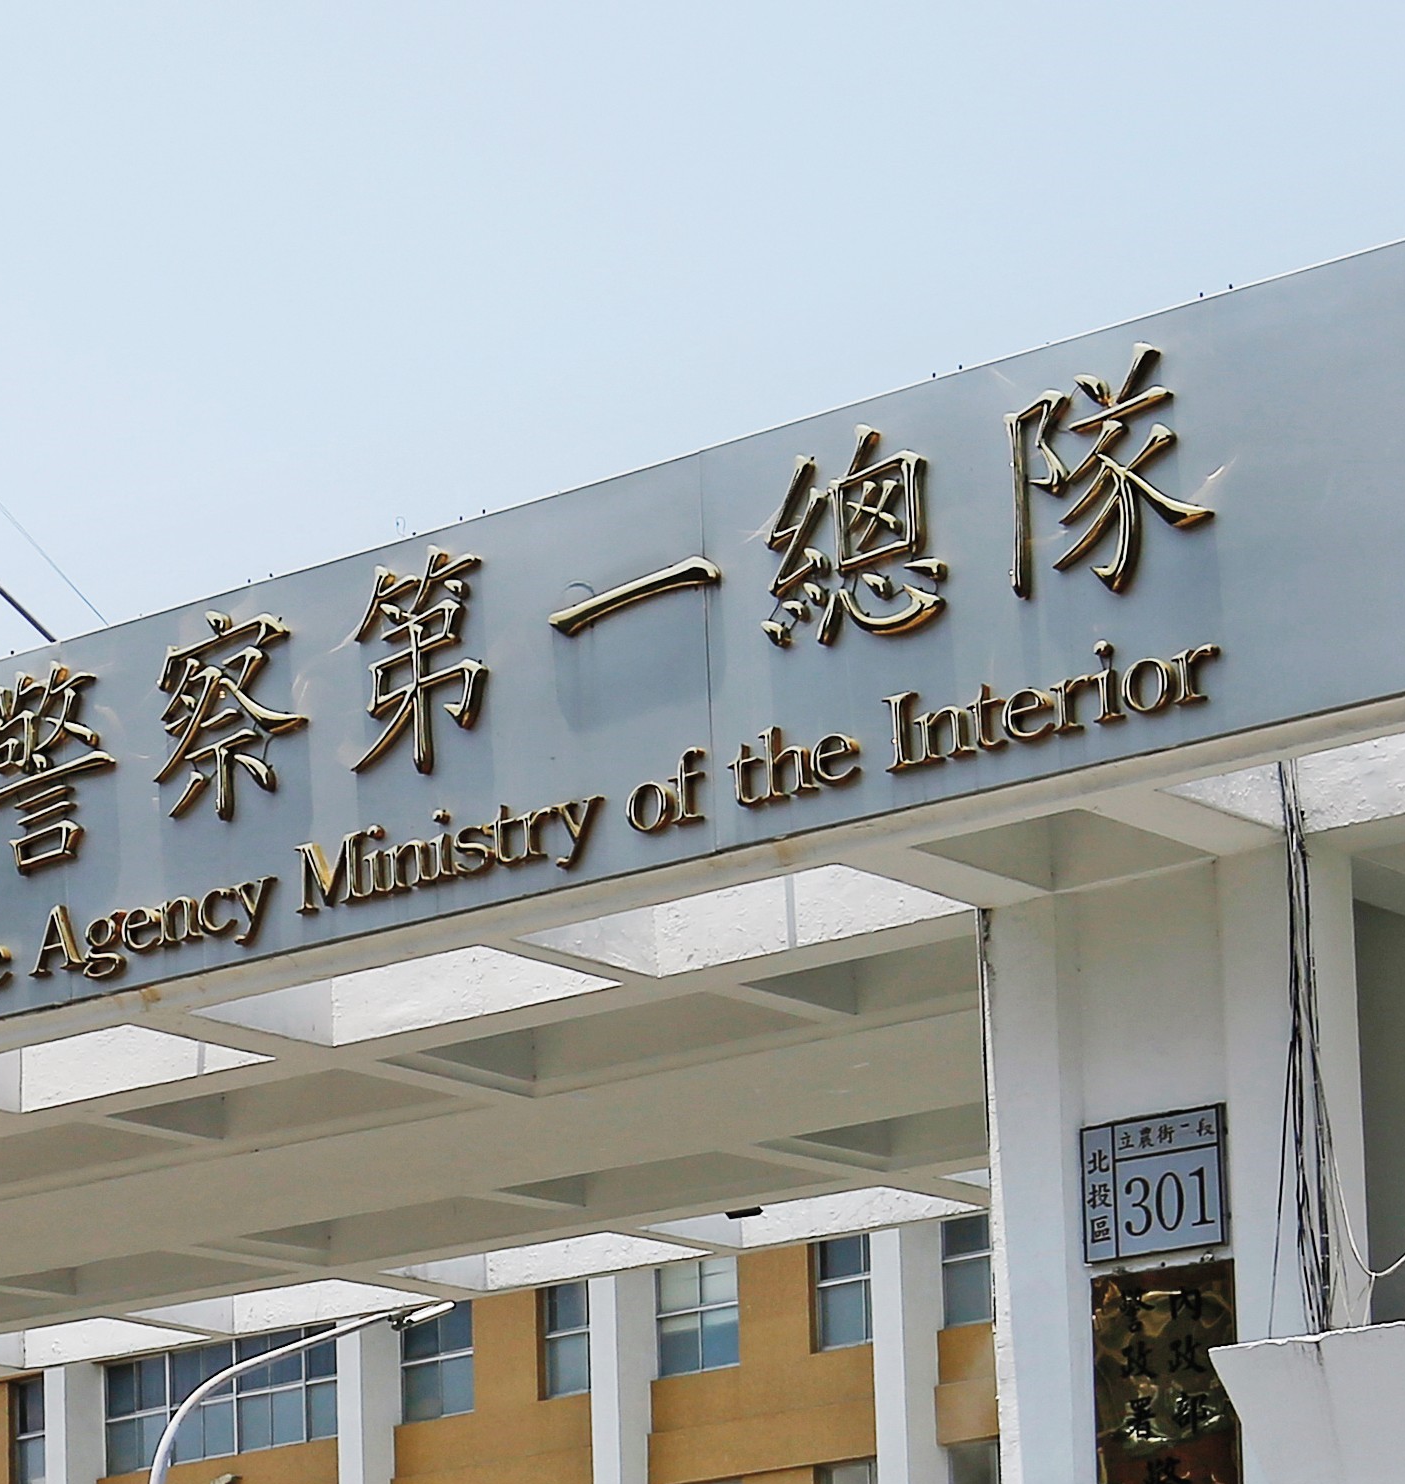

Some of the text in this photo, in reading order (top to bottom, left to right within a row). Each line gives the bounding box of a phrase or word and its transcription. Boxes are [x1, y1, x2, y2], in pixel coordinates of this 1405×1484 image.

[29, 875, 278, 980] Agency
[295, 794, 605, 915] Ministry
[625, 745, 705, 834] of
[727, 725, 863, 807] the
[882, 639, 1222, 774] Interior
[1087, 1149, 1113, 1244] 北投區
[1124, 1166, 1215, 1237] 301
